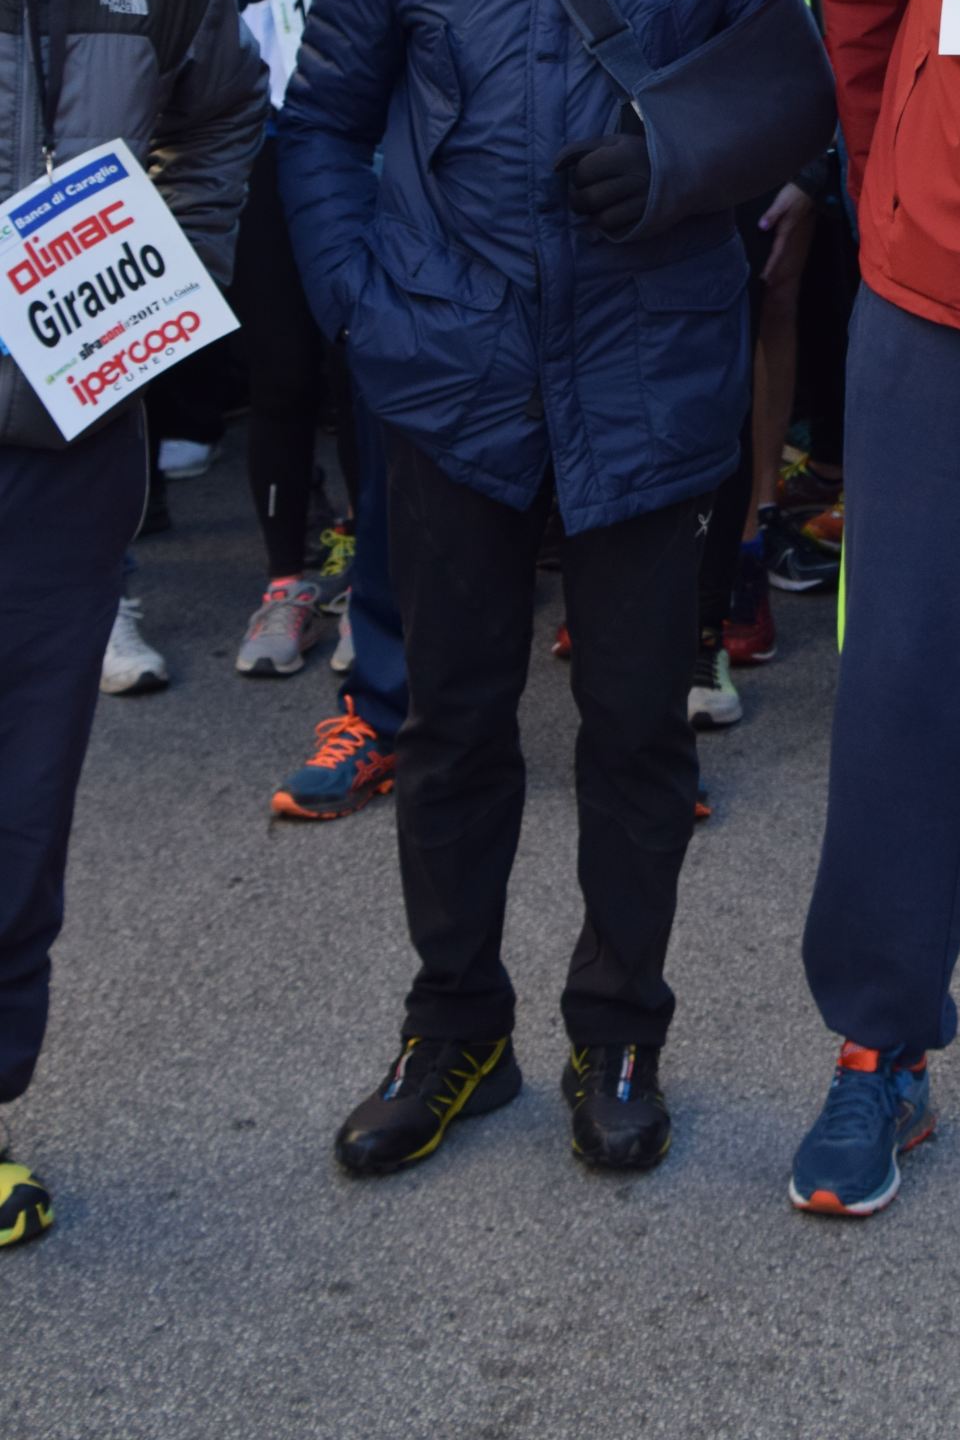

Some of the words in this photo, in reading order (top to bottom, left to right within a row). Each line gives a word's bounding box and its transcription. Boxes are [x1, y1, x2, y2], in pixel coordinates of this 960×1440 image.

[15, 202, 52, 230] Banca
[51, 191, 65, 205] di
[65, 165, 118, 195] Caraglio
[6, 200, 134, 295] olimac
[28, 241, 166, 348] Giraudo
[66, 311, 201, 406] ipercoop
[113, 347, 175, 391] CUNEO
